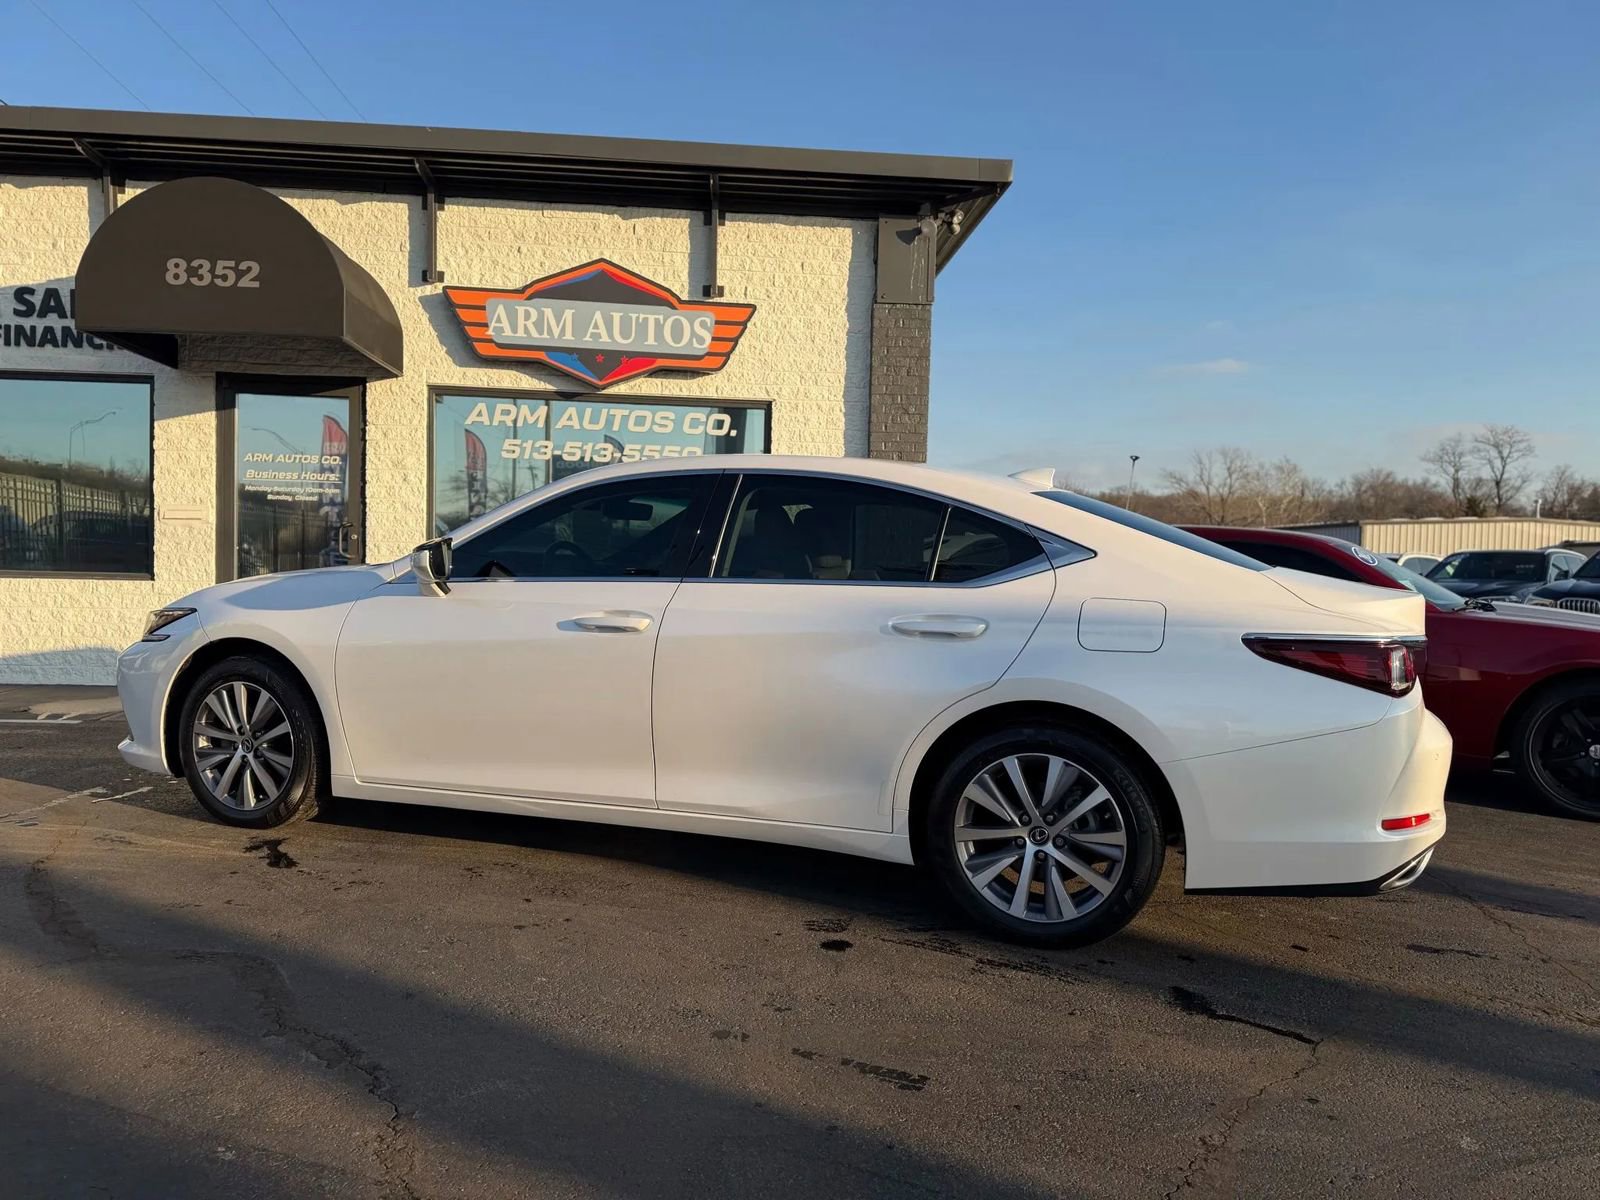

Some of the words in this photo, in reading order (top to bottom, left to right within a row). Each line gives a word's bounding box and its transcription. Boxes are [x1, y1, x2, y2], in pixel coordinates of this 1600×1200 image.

[165, 257, 261, 288] 8352
[485, 303, 576, 341] ARM
[583, 310, 712, 349] AUTOS
[465, 402, 549, 428] ARM
[556, 407, 675, 433] AUTOS
[682, 412, 737, 437] CO.
[243, 453, 273, 462] ARM
[275, 454, 320, 464] AUTOS
[321, 455, 343, 465] CO.
[246, 469, 299, 480] Business
[301, 471, 340, 481] Hours:
